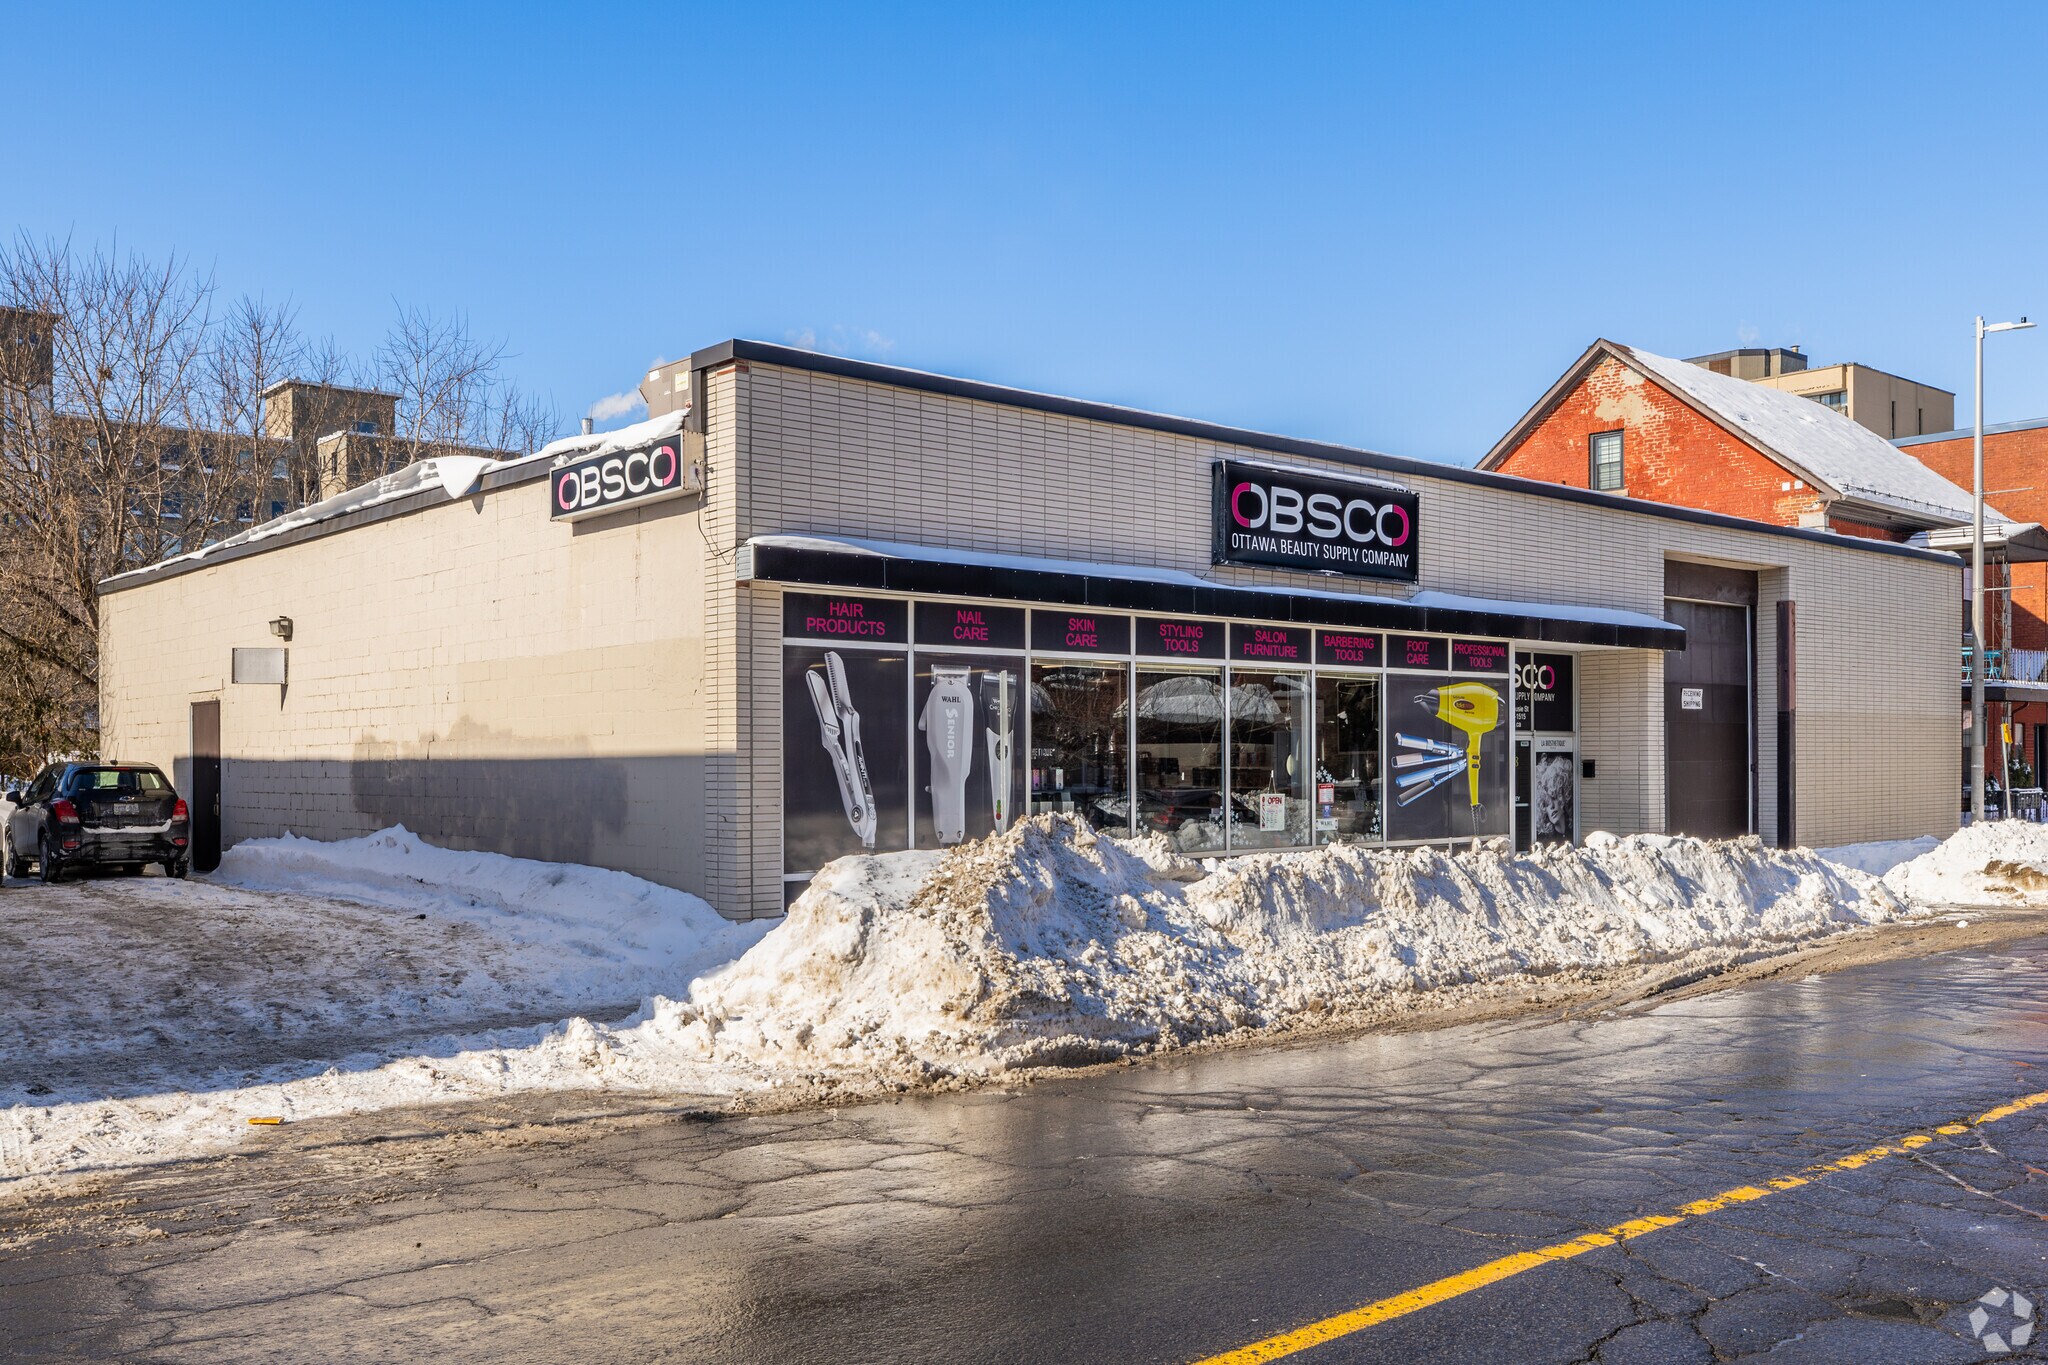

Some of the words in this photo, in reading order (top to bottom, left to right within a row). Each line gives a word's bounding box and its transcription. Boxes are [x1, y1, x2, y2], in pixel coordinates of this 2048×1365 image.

[558, 445, 677, 511] OBSCO
[1231, 481, 1410, 547] OBSCO
[1231, 533, 1277, 553] OTTAWA
[1281, 538, 1320, 558] BEAUTY
[1323, 543, 1359, 562] SUPPLY
[1361, 549, 1410, 568] COMPANY
[829, 601, 864, 618] HAIR
[956, 609, 986, 626] NAIL
[1068, 618, 1095, 632] SKIN
[806, 617, 886, 636] PRODUCTS
[953, 626, 989, 641] CARE
[1159, 624, 1204, 639] STYLING
[1065, 632, 1098, 647] CARE
[1255, 630, 1287, 644] SALON
[1323, 635, 1375, 650] BARBERING
[1163, 638, 1199, 652] TOOLS
[1243, 643, 1298, 658] FURNITURE
[1406, 640, 1429, 653] FOOT
[1453, 643, 1507, 657] PROFESSIONAL
[1334, 649, 1364, 662] TOOLS
[1406, 653, 1429, 665] CARE
[1469, 656, 1493, 668] TOOLS
[941, 695, 962, 704] WAHL
[945, 707, 959, 759] SENIOR
[1268, 796, 1282, 804] OPEN
